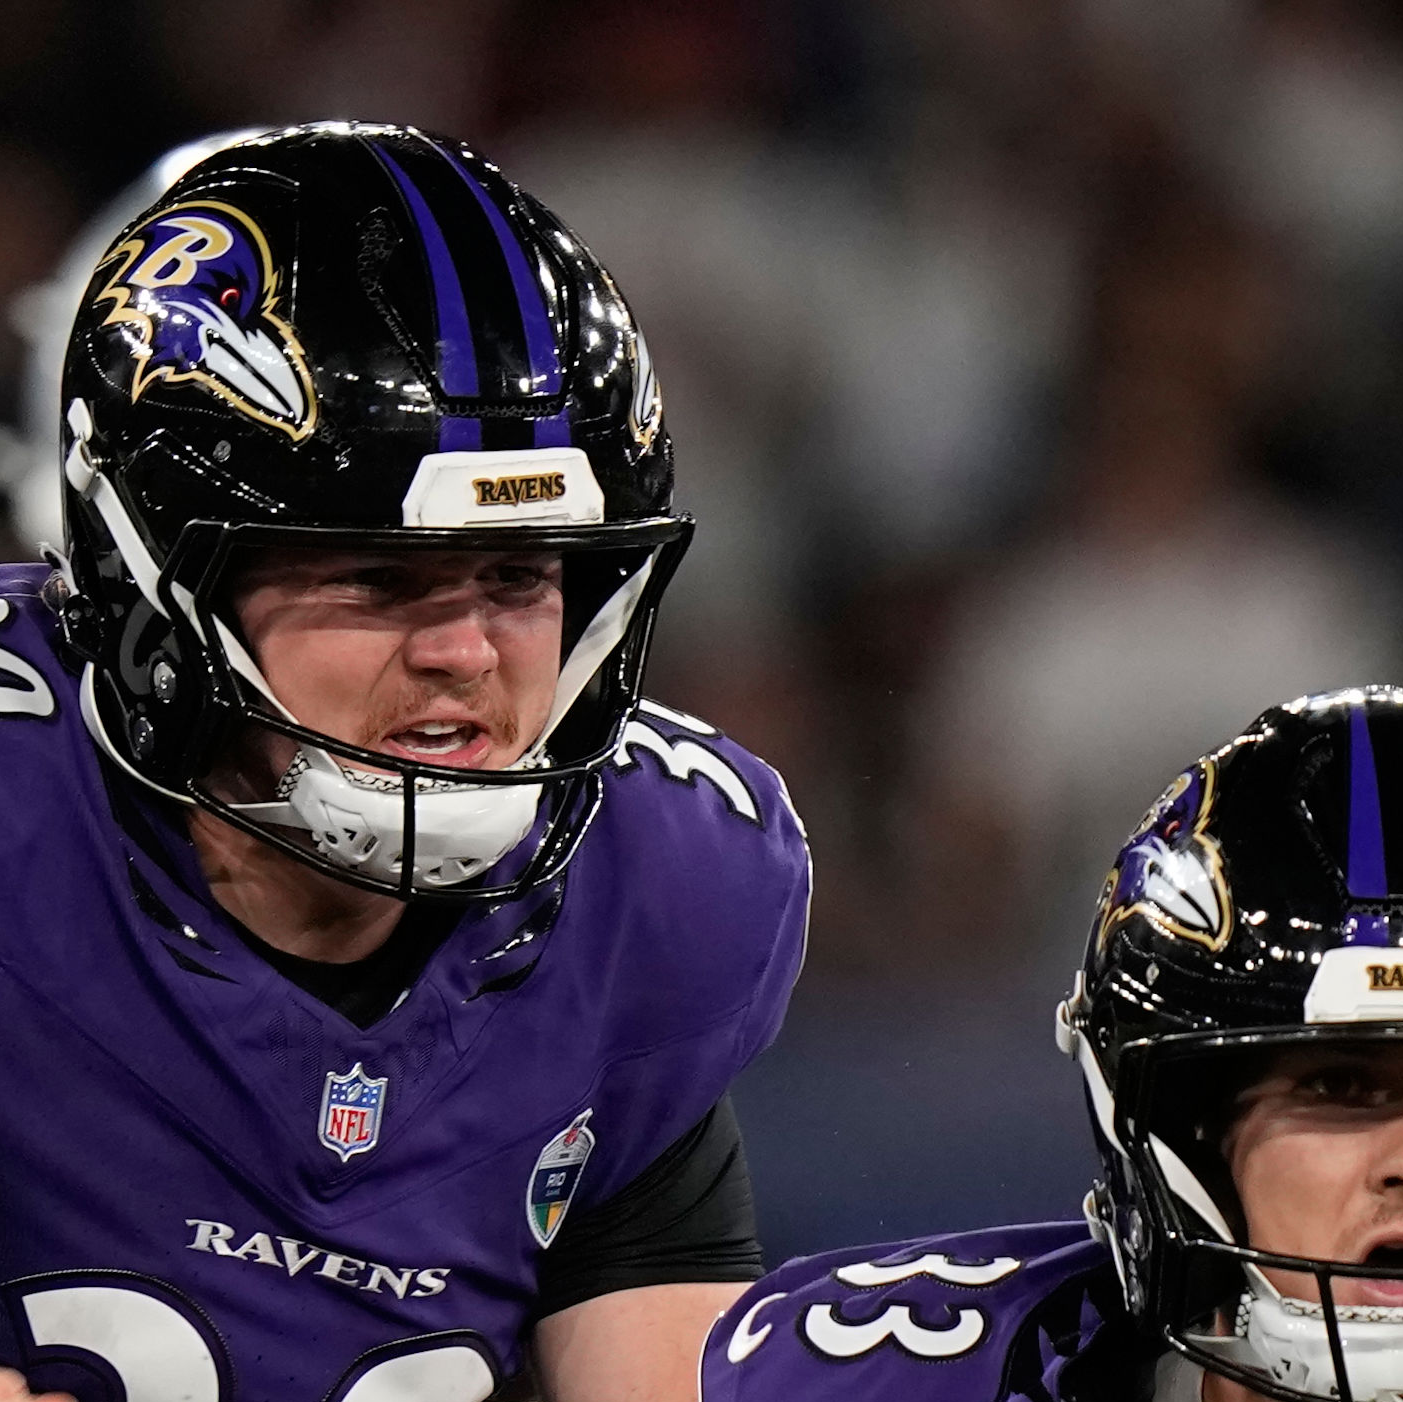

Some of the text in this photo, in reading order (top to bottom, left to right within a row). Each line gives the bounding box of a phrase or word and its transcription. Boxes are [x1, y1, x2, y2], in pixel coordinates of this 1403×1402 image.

[126, 217, 234, 289] B
[472, 472, 566, 506] RAVENS
[329, 1106, 373, 1143] NFL
[184, 1218, 452, 1301] RAVENS
[804, 1253, 1021, 1358] 33
